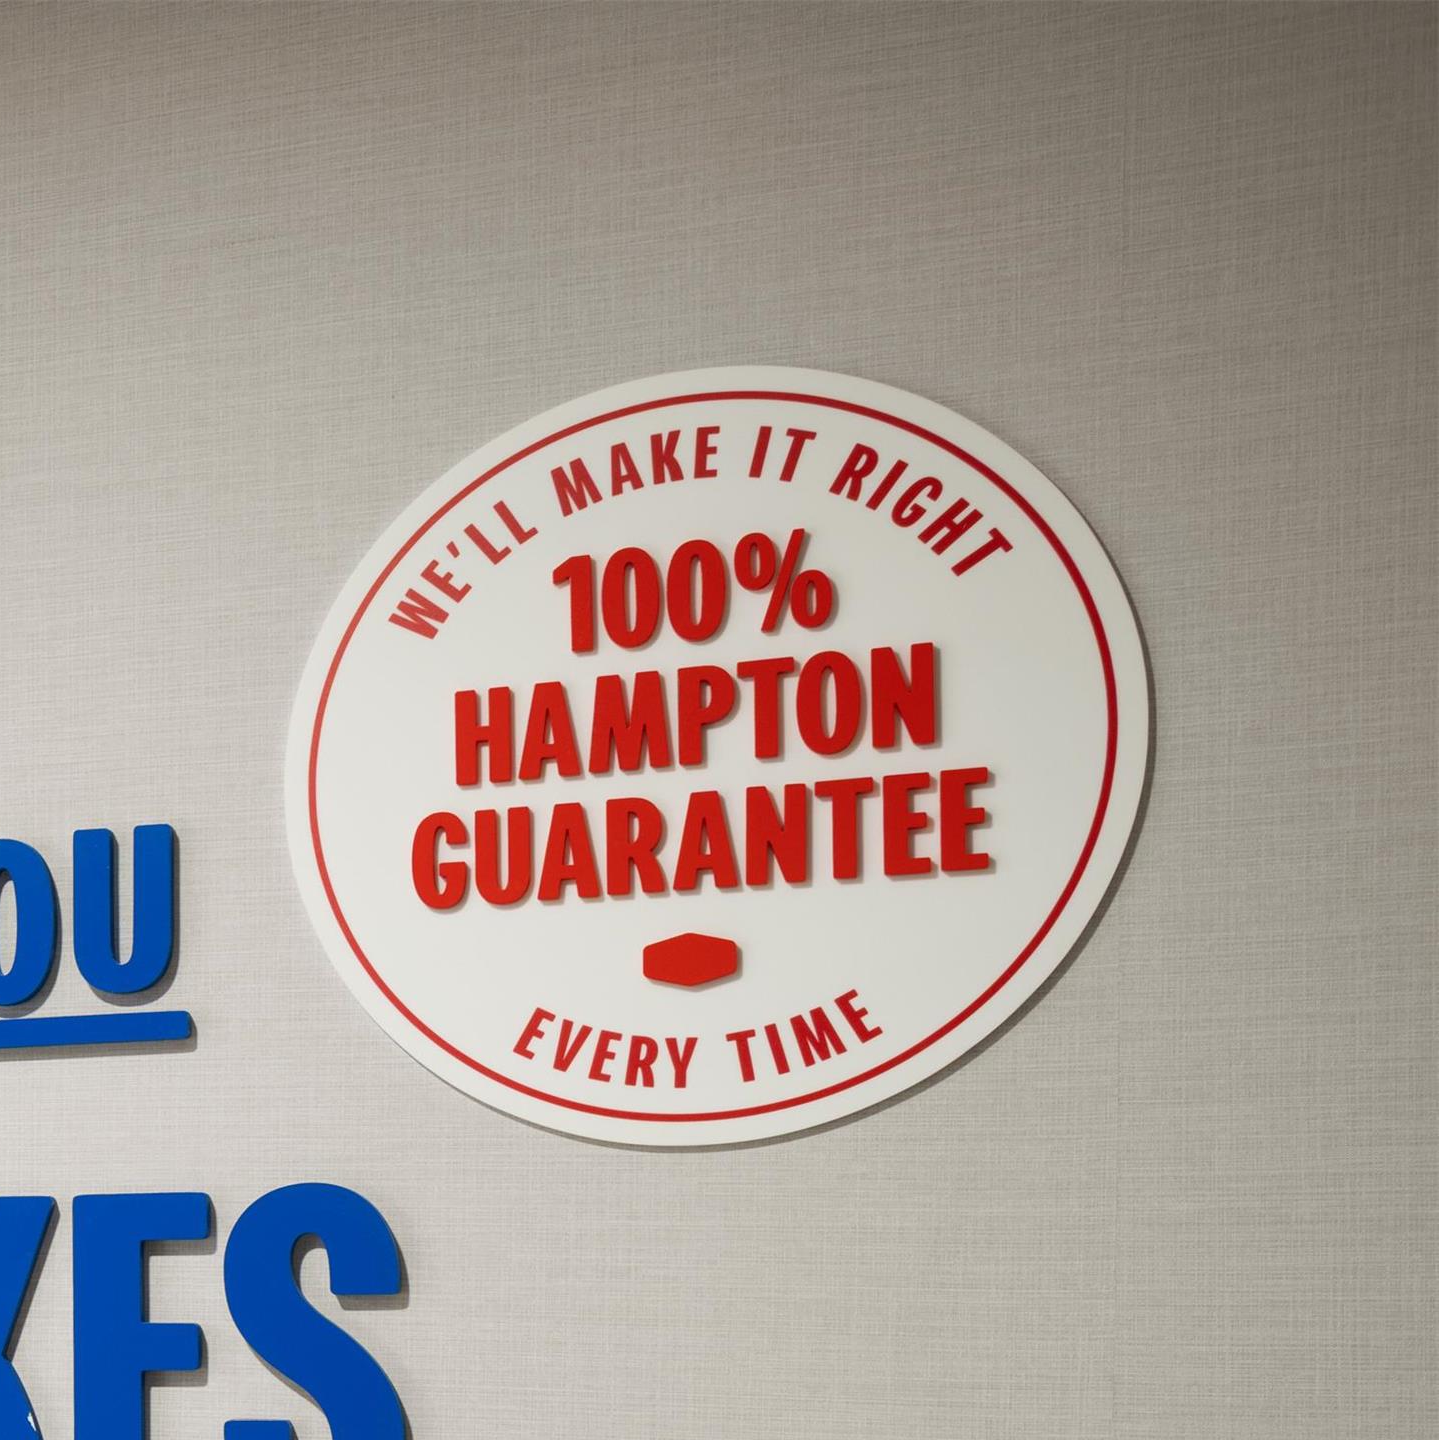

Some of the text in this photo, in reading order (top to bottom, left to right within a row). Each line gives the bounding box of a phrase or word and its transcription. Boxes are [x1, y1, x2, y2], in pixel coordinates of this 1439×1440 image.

[388, 426, 1013, 639] WE'LL MAKE IT RIGHT
[552, 528, 835, 654] 100%
[454, 642, 939, 788] HAMPTON
[411, 766, 992, 911] GUARANTEE
[513, 989, 883, 1089] EVERY TIME
